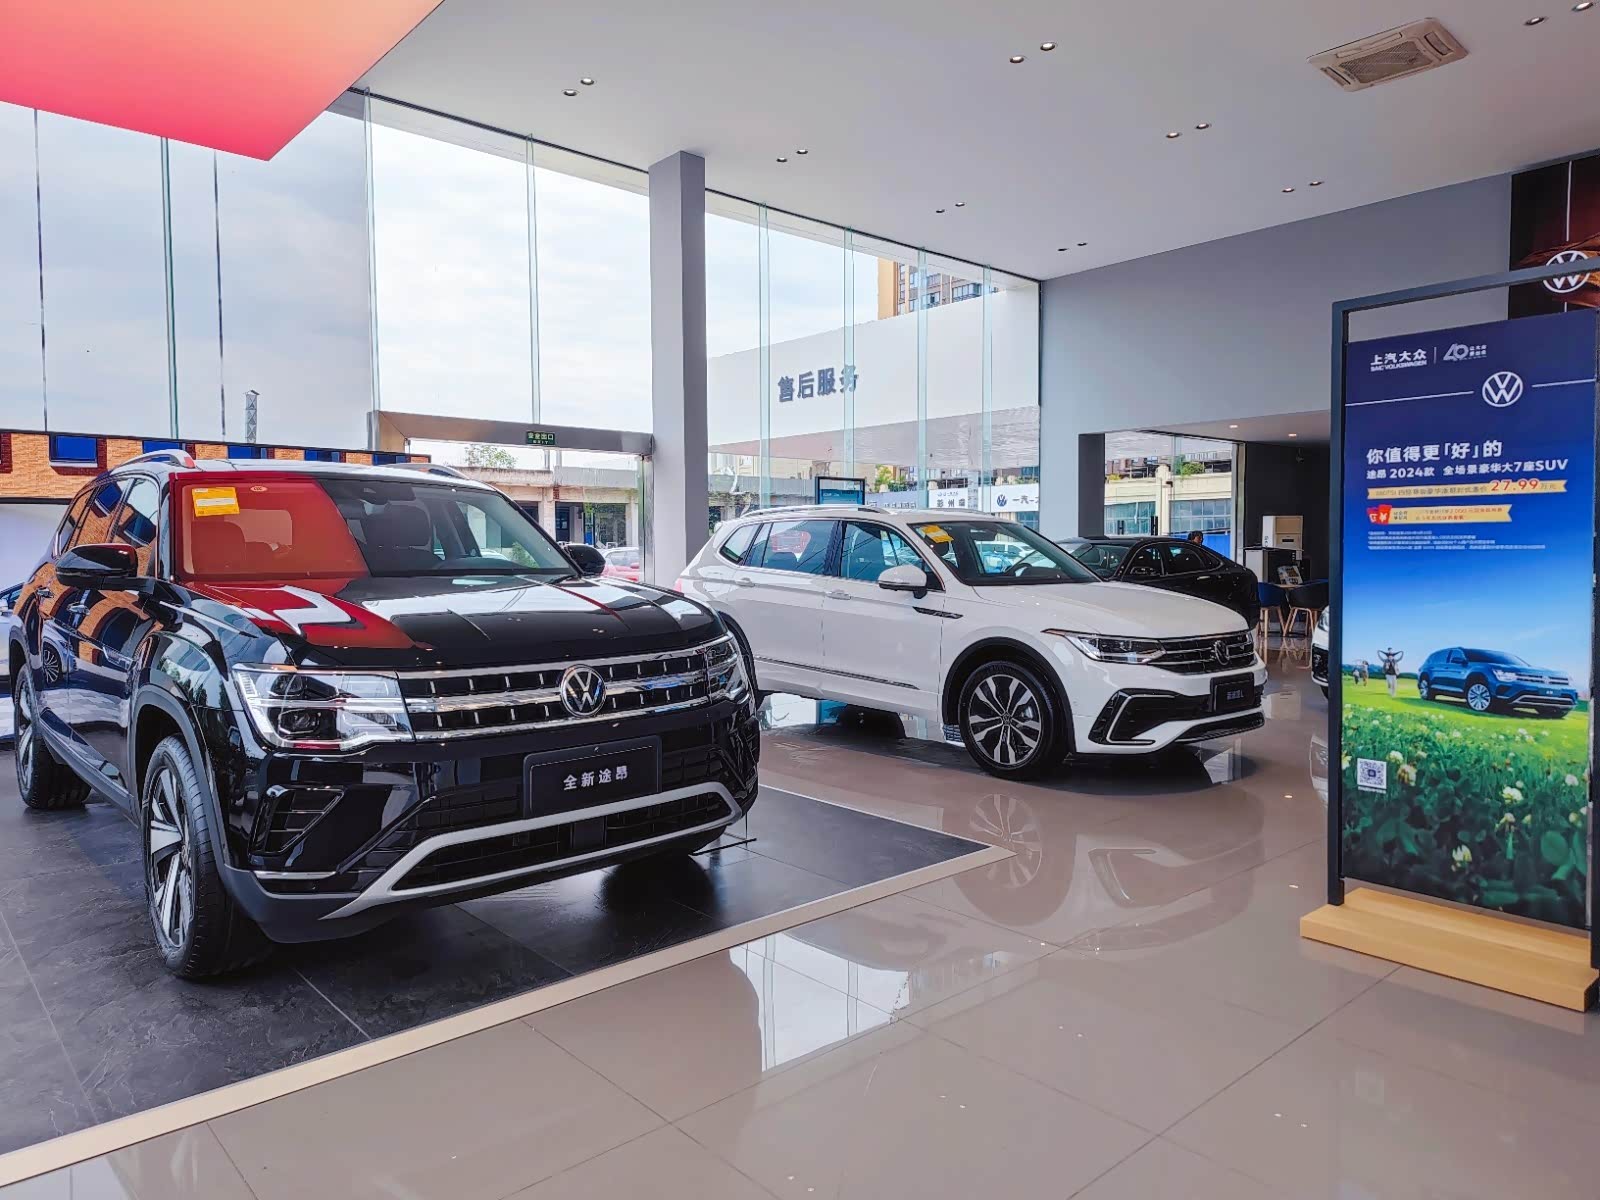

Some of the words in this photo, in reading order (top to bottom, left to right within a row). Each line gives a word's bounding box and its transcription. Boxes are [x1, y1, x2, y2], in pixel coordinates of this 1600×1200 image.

[1370, 348, 1427, 365] 上汽大众
[778, 364, 859, 403] 售后服务
[528, 432, 553, 440] 安全出口
[1366, 440, 1503, 465] 你值得更「好」的
[1389, 466, 1435, 479] 2024款
[1443, 458, 1569, 477] 全场景豪华大7座SUV
[1490, 479, 1539, 492] 27.99
[563, 765, 629, 791] 全新途昂
